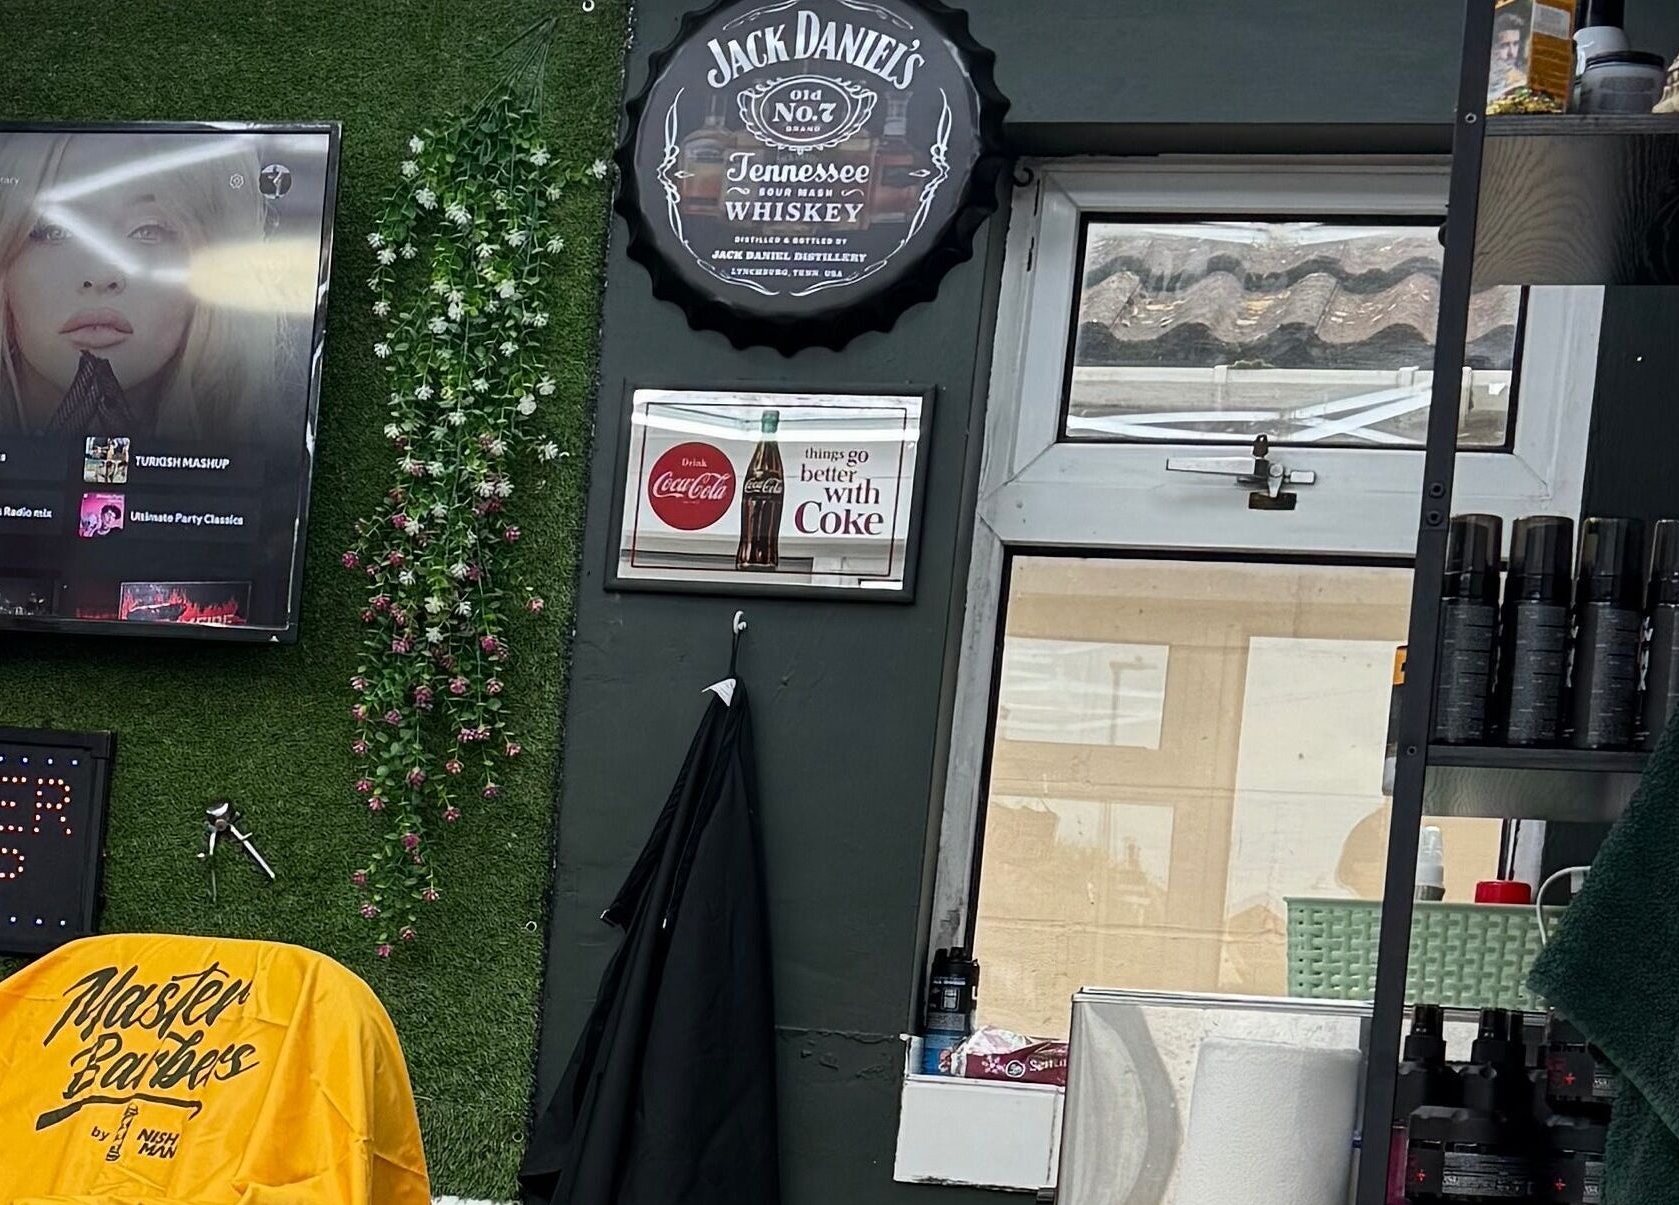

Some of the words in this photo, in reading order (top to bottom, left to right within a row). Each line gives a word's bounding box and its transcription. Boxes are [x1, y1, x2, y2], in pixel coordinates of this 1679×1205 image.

[706, 23, 790, 88] JACK
[794, 9, 925, 90] DANIEL'S
[790, 88, 821, 100] Old
[726, 152, 870, 183] Tennessee
[759, 187, 792, 197] SOUR
[798, 188, 833, 197] MASH
[725, 201, 864, 222] WHISKEY
[711, 250, 743, 261] JACK
[746, 250, 791, 261] DANIEL
[794, 252, 867, 262] DISTILLERY
[135, 455, 181, 469] TURKISH
[182, 457, 230, 470] MASHUP
[681, 458, 708, 468] Drink
[805, 446, 845, 463] things
[848, 450, 869, 468] go
[800, 463, 858, 483] better
[824, 478, 880, 505] with
[4, 506, 32, 517] Radio
[33, 508, 52, 518] mix
[130, 511, 173, 523] Ultimate
[175, 512, 203, 526] Party
[203, 514, 244, 526] Classics
[794, 500, 884, 536] Coke
[43, 961, 253, 1047] Master
[62, 1029, 261, 1100] Barbers
[90, 1126, 110, 1142] by
[137, 1128, 180, 1145] NISH
[138, 1142, 177, 1159] MAN
